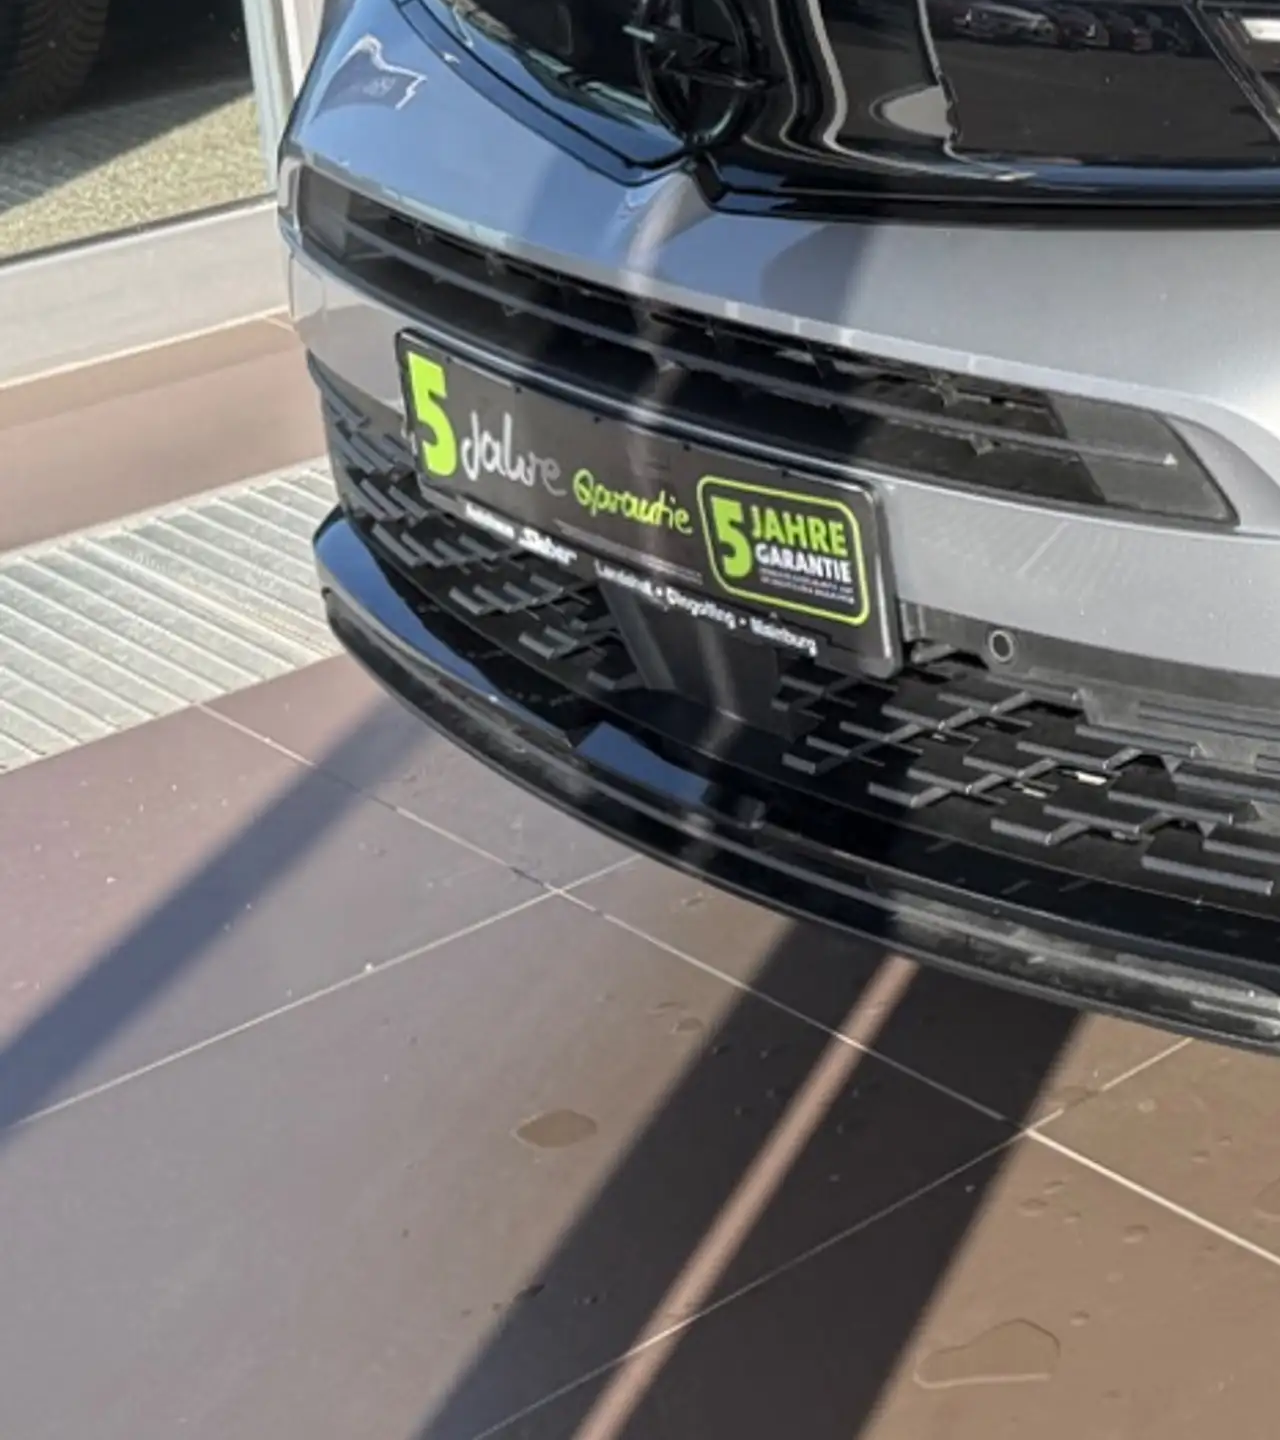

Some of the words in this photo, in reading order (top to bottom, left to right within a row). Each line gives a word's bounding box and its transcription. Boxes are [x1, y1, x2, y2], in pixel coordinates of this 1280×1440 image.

[407, 351, 457, 477] 5
[712, 495, 752, 579] 5
[752, 504, 848, 557] JAHRE
[755, 543, 852, 585] GARANTIE
